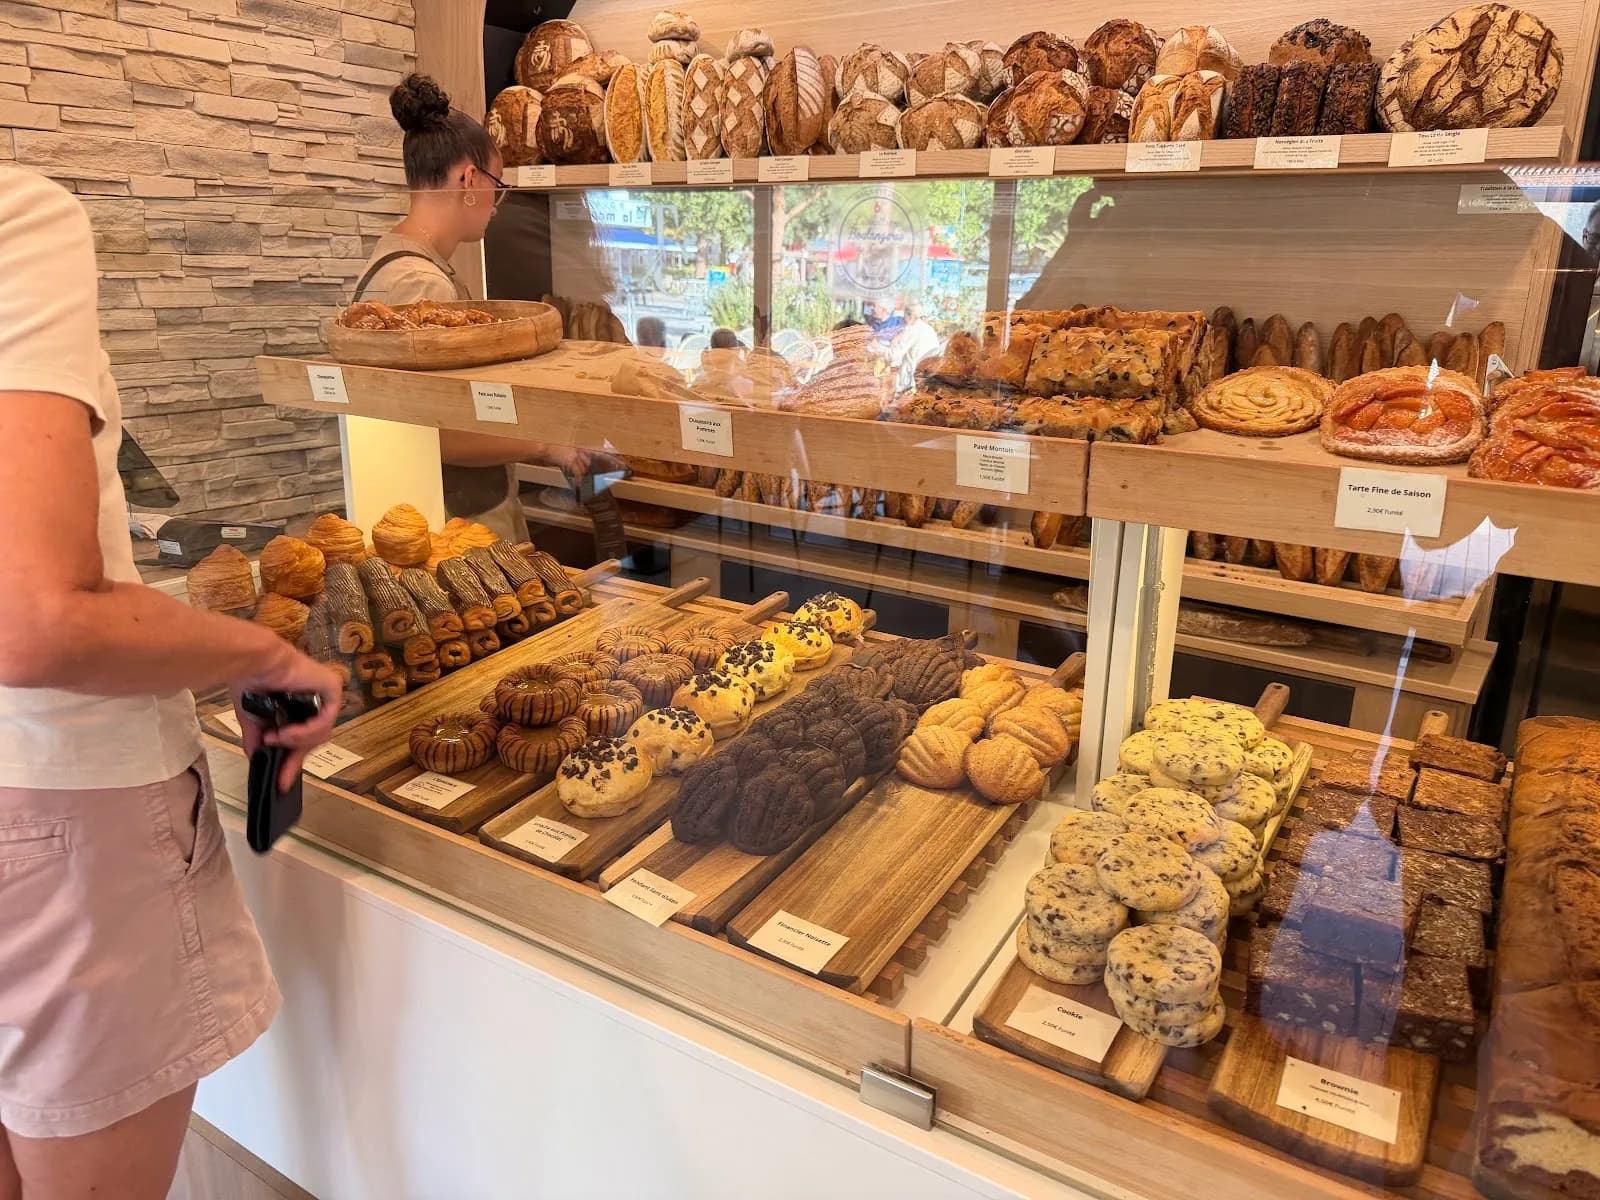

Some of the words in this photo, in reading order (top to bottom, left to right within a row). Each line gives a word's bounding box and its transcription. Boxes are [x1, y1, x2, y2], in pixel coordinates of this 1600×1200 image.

[973, 443, 988, 451] Pavé
[989, 445, 1014, 454] Montois
[1347, 484, 1369, 494] Tarte
[1371, 486, 1390, 496] Fine
[1391, 488, 1402, 497] de
[1403, 489, 1431, 499] Saison
[776, 921, 805, 935] Financier
[805, 933, 831, 946] Noisette
[1057, 1005, 1084, 1020] Cookie
[1320, 1077, 1359, 1096] Brownie
